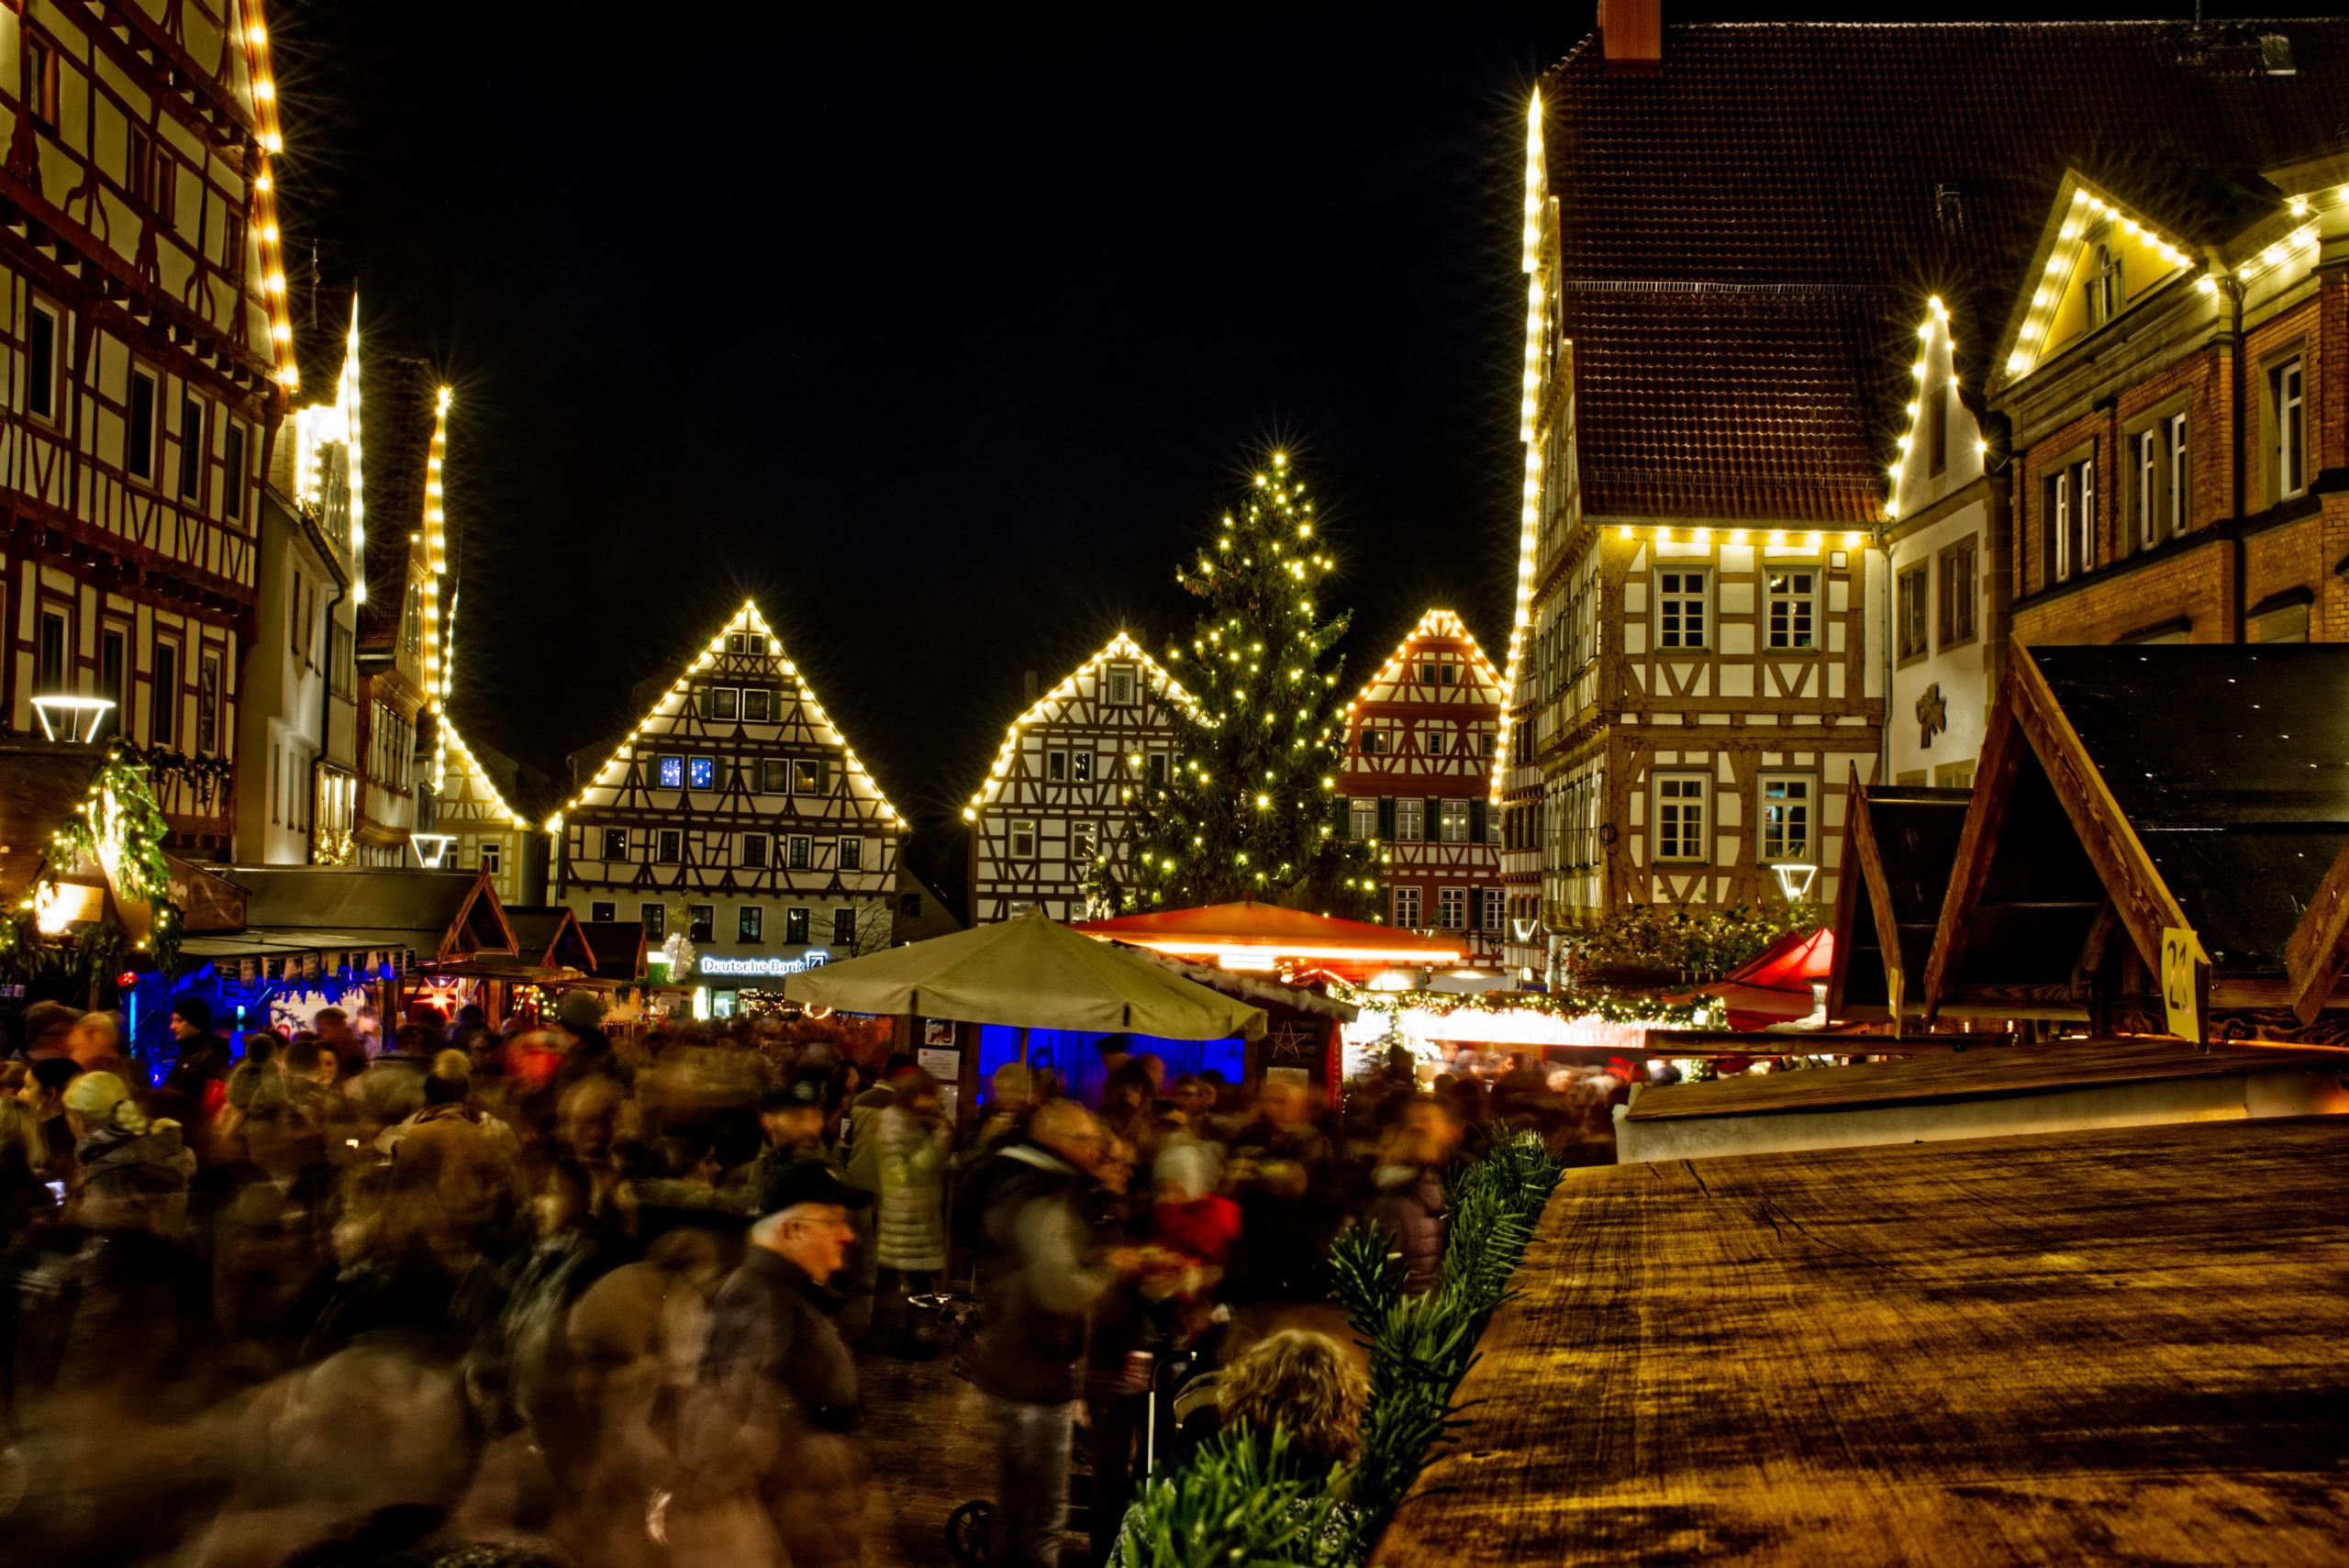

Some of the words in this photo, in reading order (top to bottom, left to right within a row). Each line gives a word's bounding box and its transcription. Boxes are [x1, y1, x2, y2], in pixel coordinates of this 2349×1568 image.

[703, 959, 768, 972] Deutsche
[771, 960, 805, 973] Bank
[2166, 940, 2191, 1014] 21
